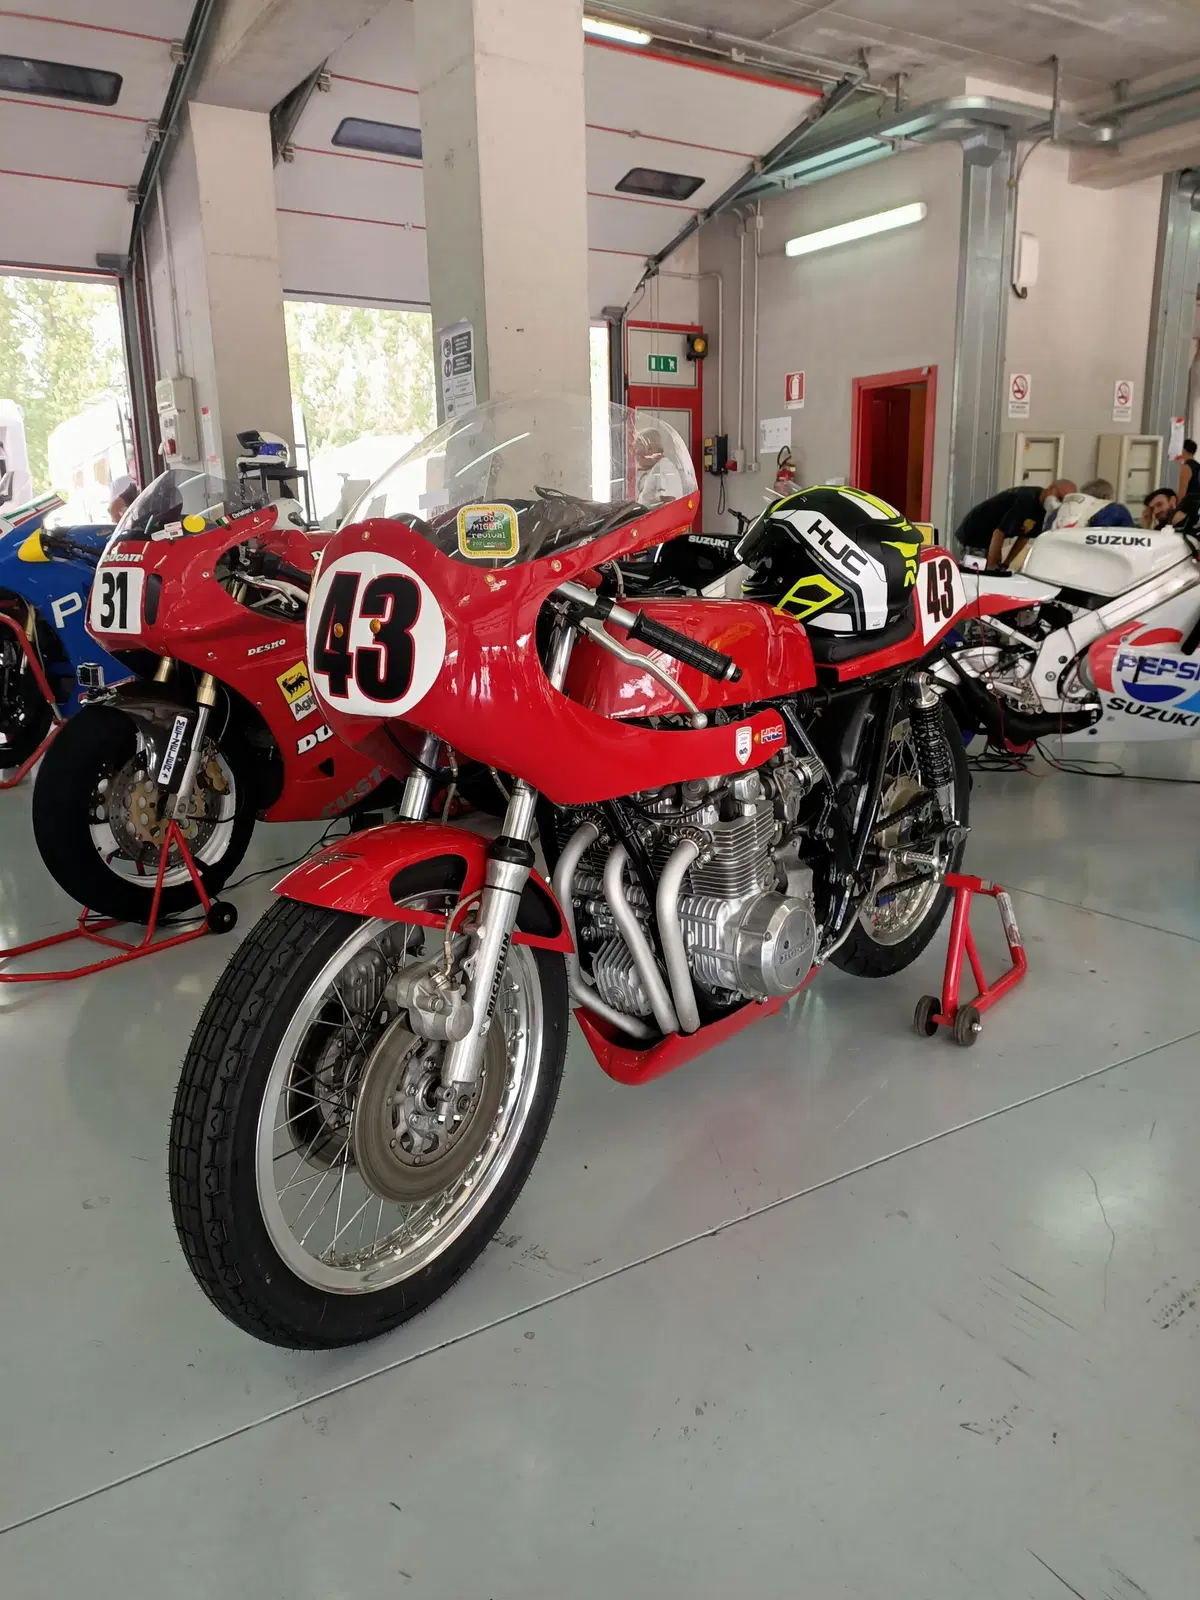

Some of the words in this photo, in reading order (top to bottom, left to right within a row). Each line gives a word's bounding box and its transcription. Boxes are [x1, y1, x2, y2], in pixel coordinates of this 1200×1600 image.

[472, 531, 506, 539] revival
[688, 535, 730, 548] SUZUKI
[806, 519, 869, 577] HJC
[1085, 534, 1152, 547] SUZUKI
[100, 571, 128, 629] 31
[926, 558, 954, 623] 43
[247, 638, 286, 656] DESMO
[313, 571, 422, 704] 43
[1116, 654, 1200, 681] PEPSI
[1106, 697, 1200, 727] SUZUKI
[163, 719, 186, 773] METZELER
[486, 932, 510, 1018] MICHELIN
